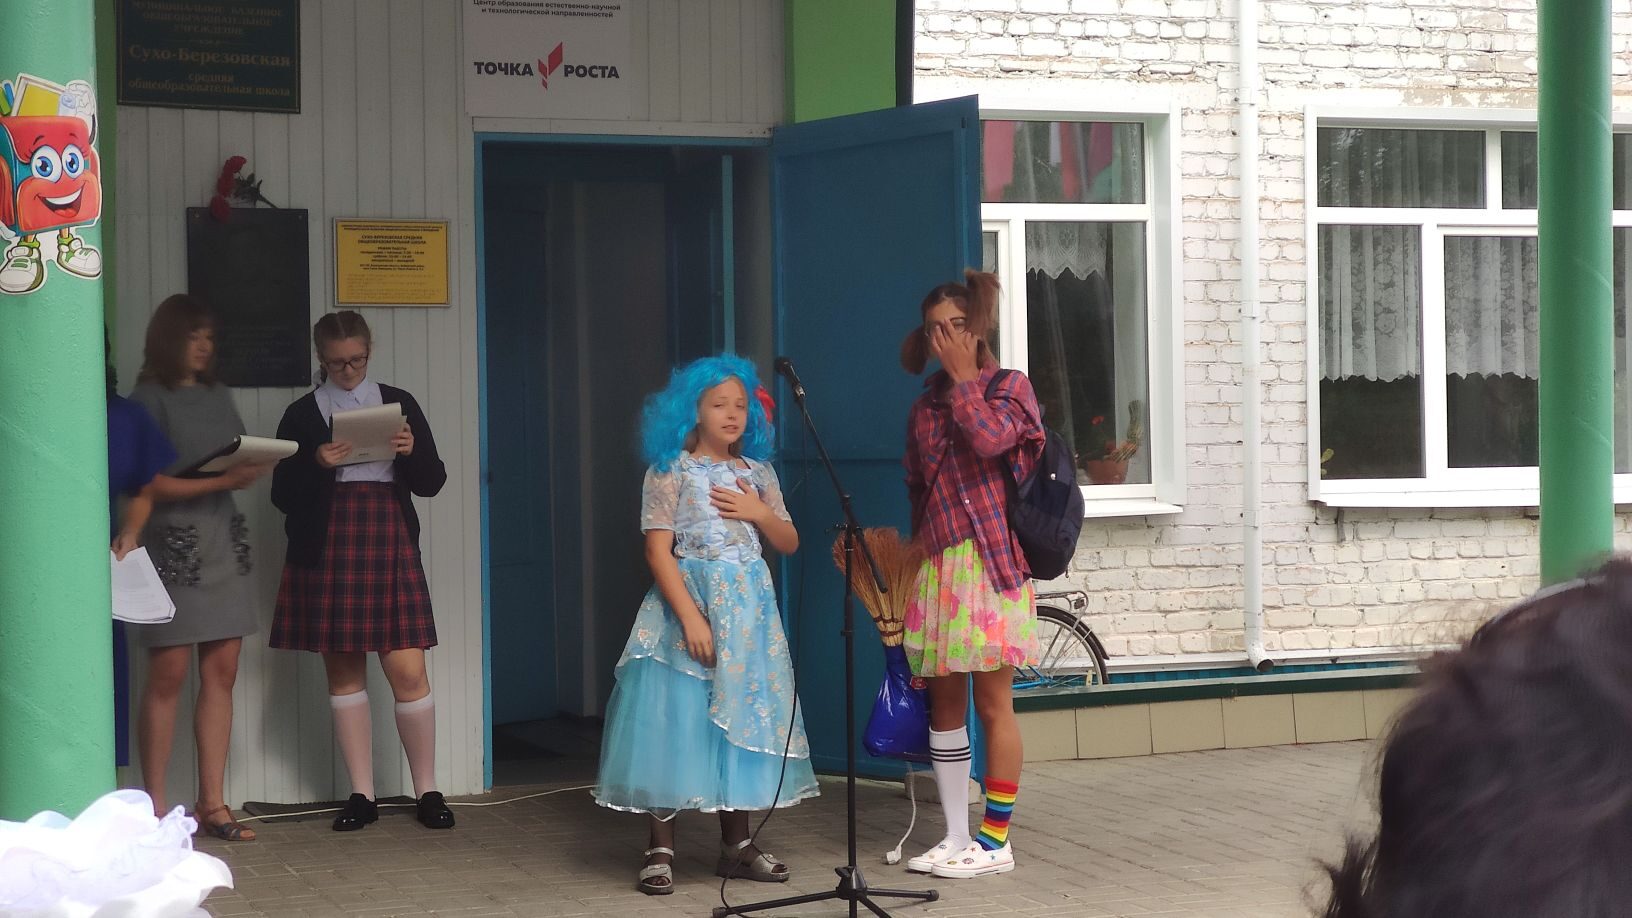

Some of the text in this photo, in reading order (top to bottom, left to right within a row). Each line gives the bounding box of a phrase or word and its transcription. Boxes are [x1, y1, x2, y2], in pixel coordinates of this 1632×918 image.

[545, 2, 621, 11] естественно-научной
[551, 9, 614, 18] направленностей
[128, 44, 290, 67] Сухо-Березовская
[474, 61, 620, 79] ТОЧКА РОСТА
[128, 78, 290, 97] общеобразовательная школа
